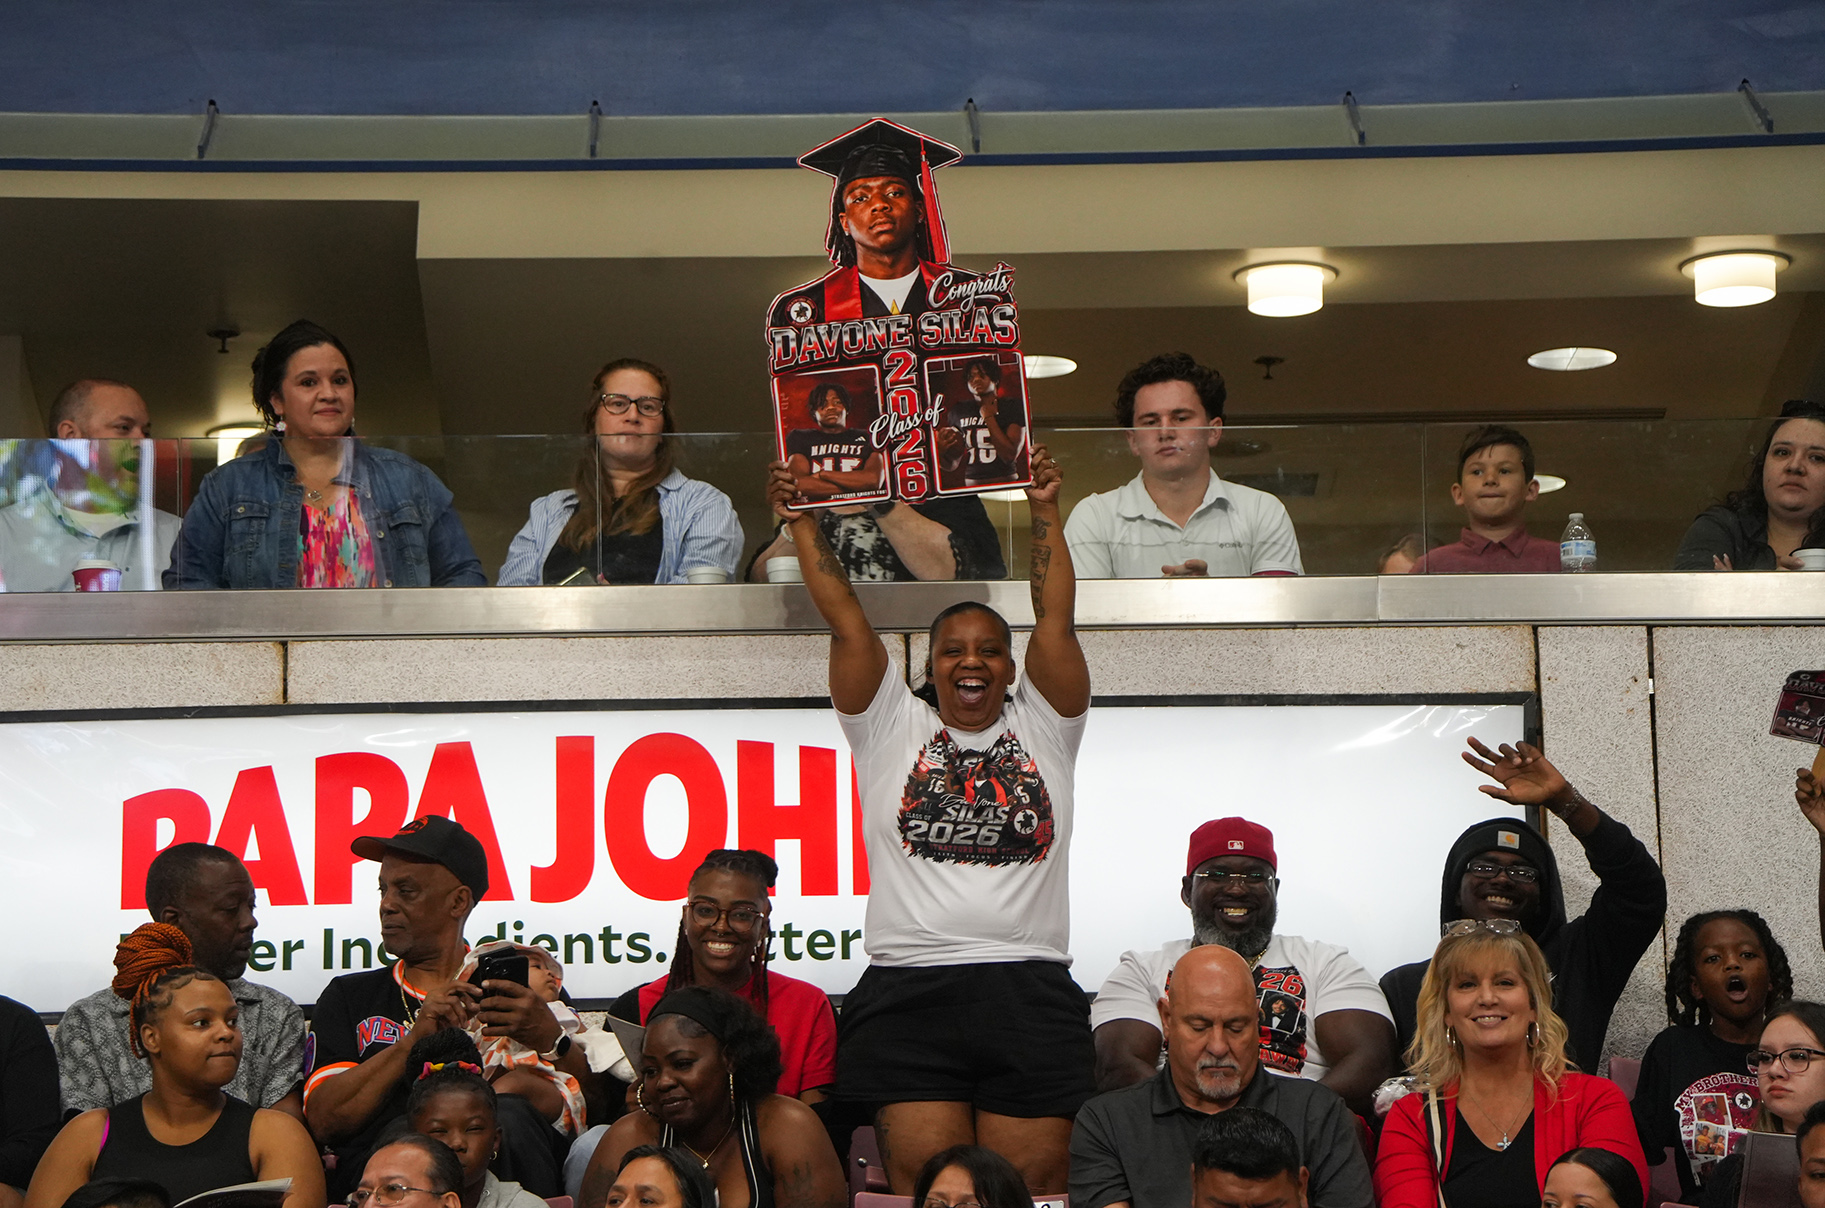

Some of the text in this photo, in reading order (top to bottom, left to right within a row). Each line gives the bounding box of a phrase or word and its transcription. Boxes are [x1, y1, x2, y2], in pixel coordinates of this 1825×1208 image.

[929, 264, 1012, 312] Congrats
[772, 305, 1017, 370] DAVONE SILAS
[870, 394, 944, 449] Class of
[121, 742, 514, 909] PAPA
[906, 819, 1003, 846] 2026
[943, 805, 1010, 824] SILAS
[1258, 972, 1304, 996] 26
[1675, 1088, 1694, 1111] MY
